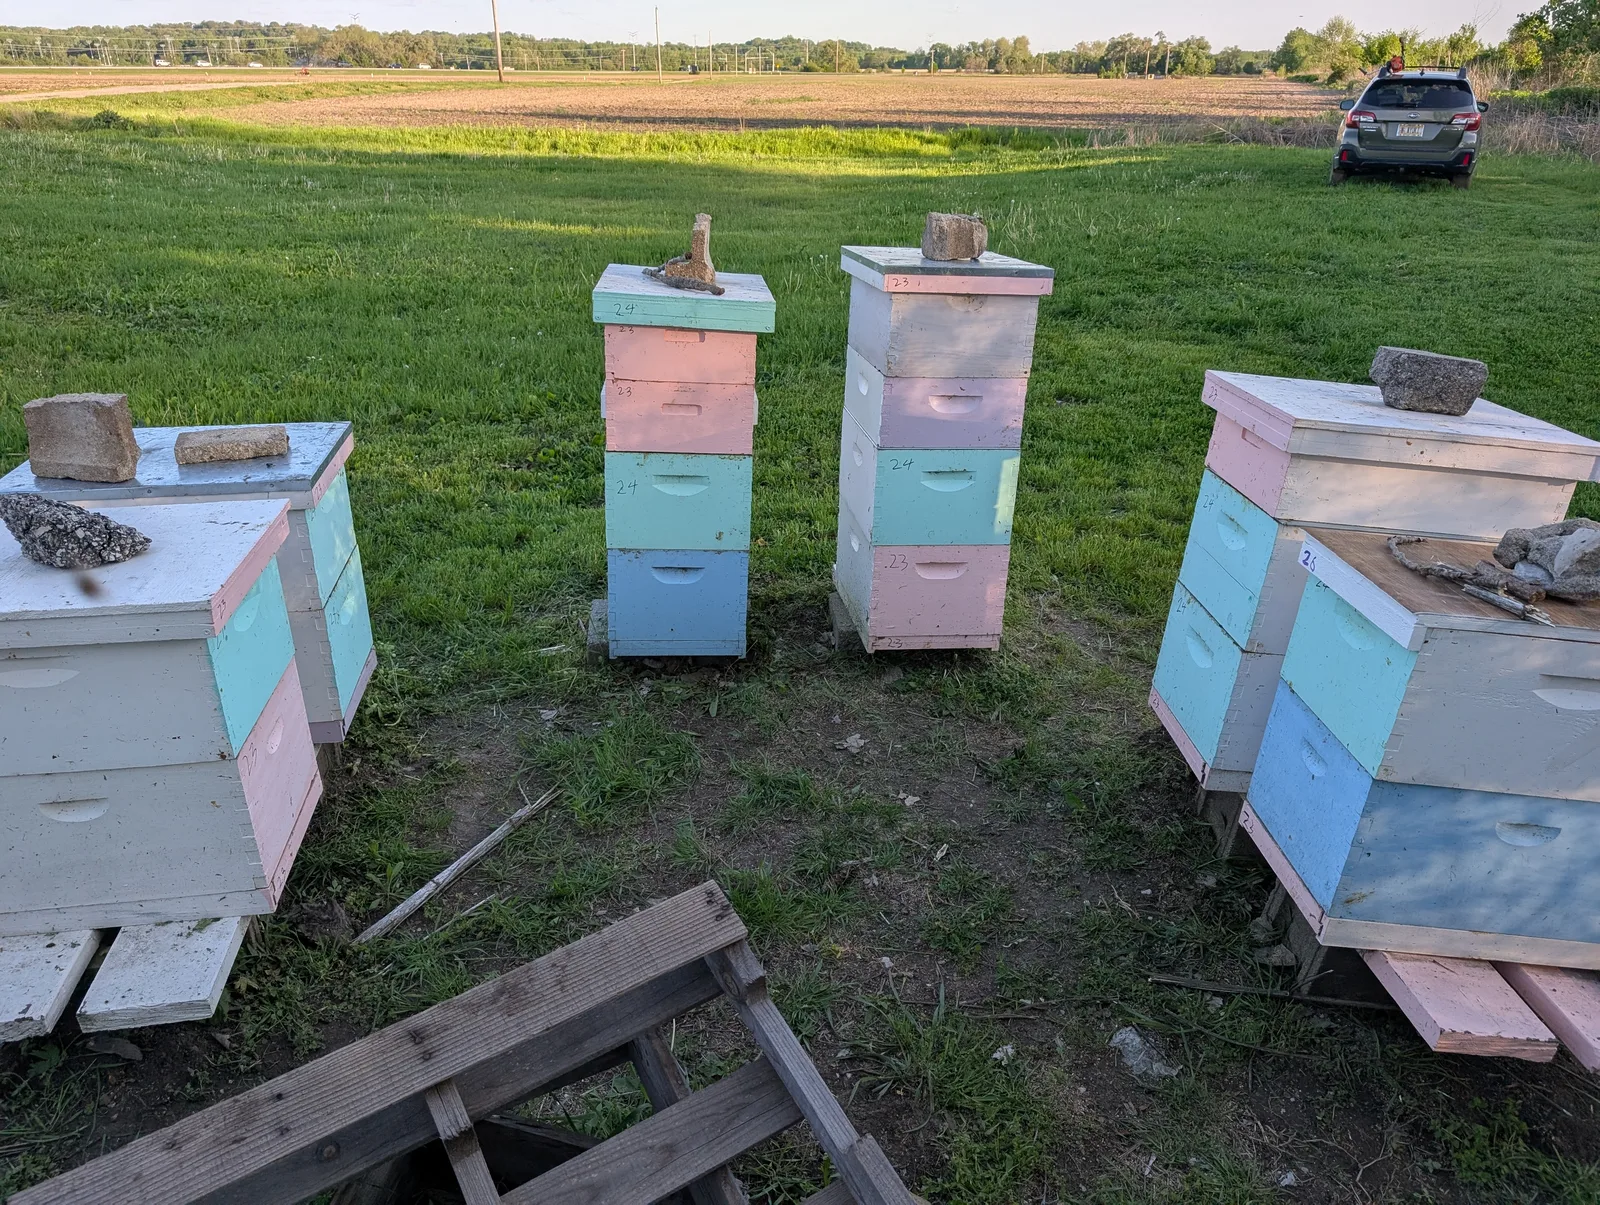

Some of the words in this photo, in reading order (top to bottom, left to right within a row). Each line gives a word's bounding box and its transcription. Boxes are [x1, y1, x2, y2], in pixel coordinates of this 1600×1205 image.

[892, 277, 909, 287] 23
[614, 303, 636, 317] 24
[619, 325, 635, 334] 23
[618, 386, 632, 397] 23
[1208, 385, 1218, 402] 23
[890, 458, 914, 470] 24
[616, 479, 638, 495] 24
[1203, 495, 1214, 512] 24
[889, 554, 909, 571] 23
[1301, 550, 1317, 572] 26
[887, 637, 903, 648] 23
[1242, 810, 1254, 834] 23
